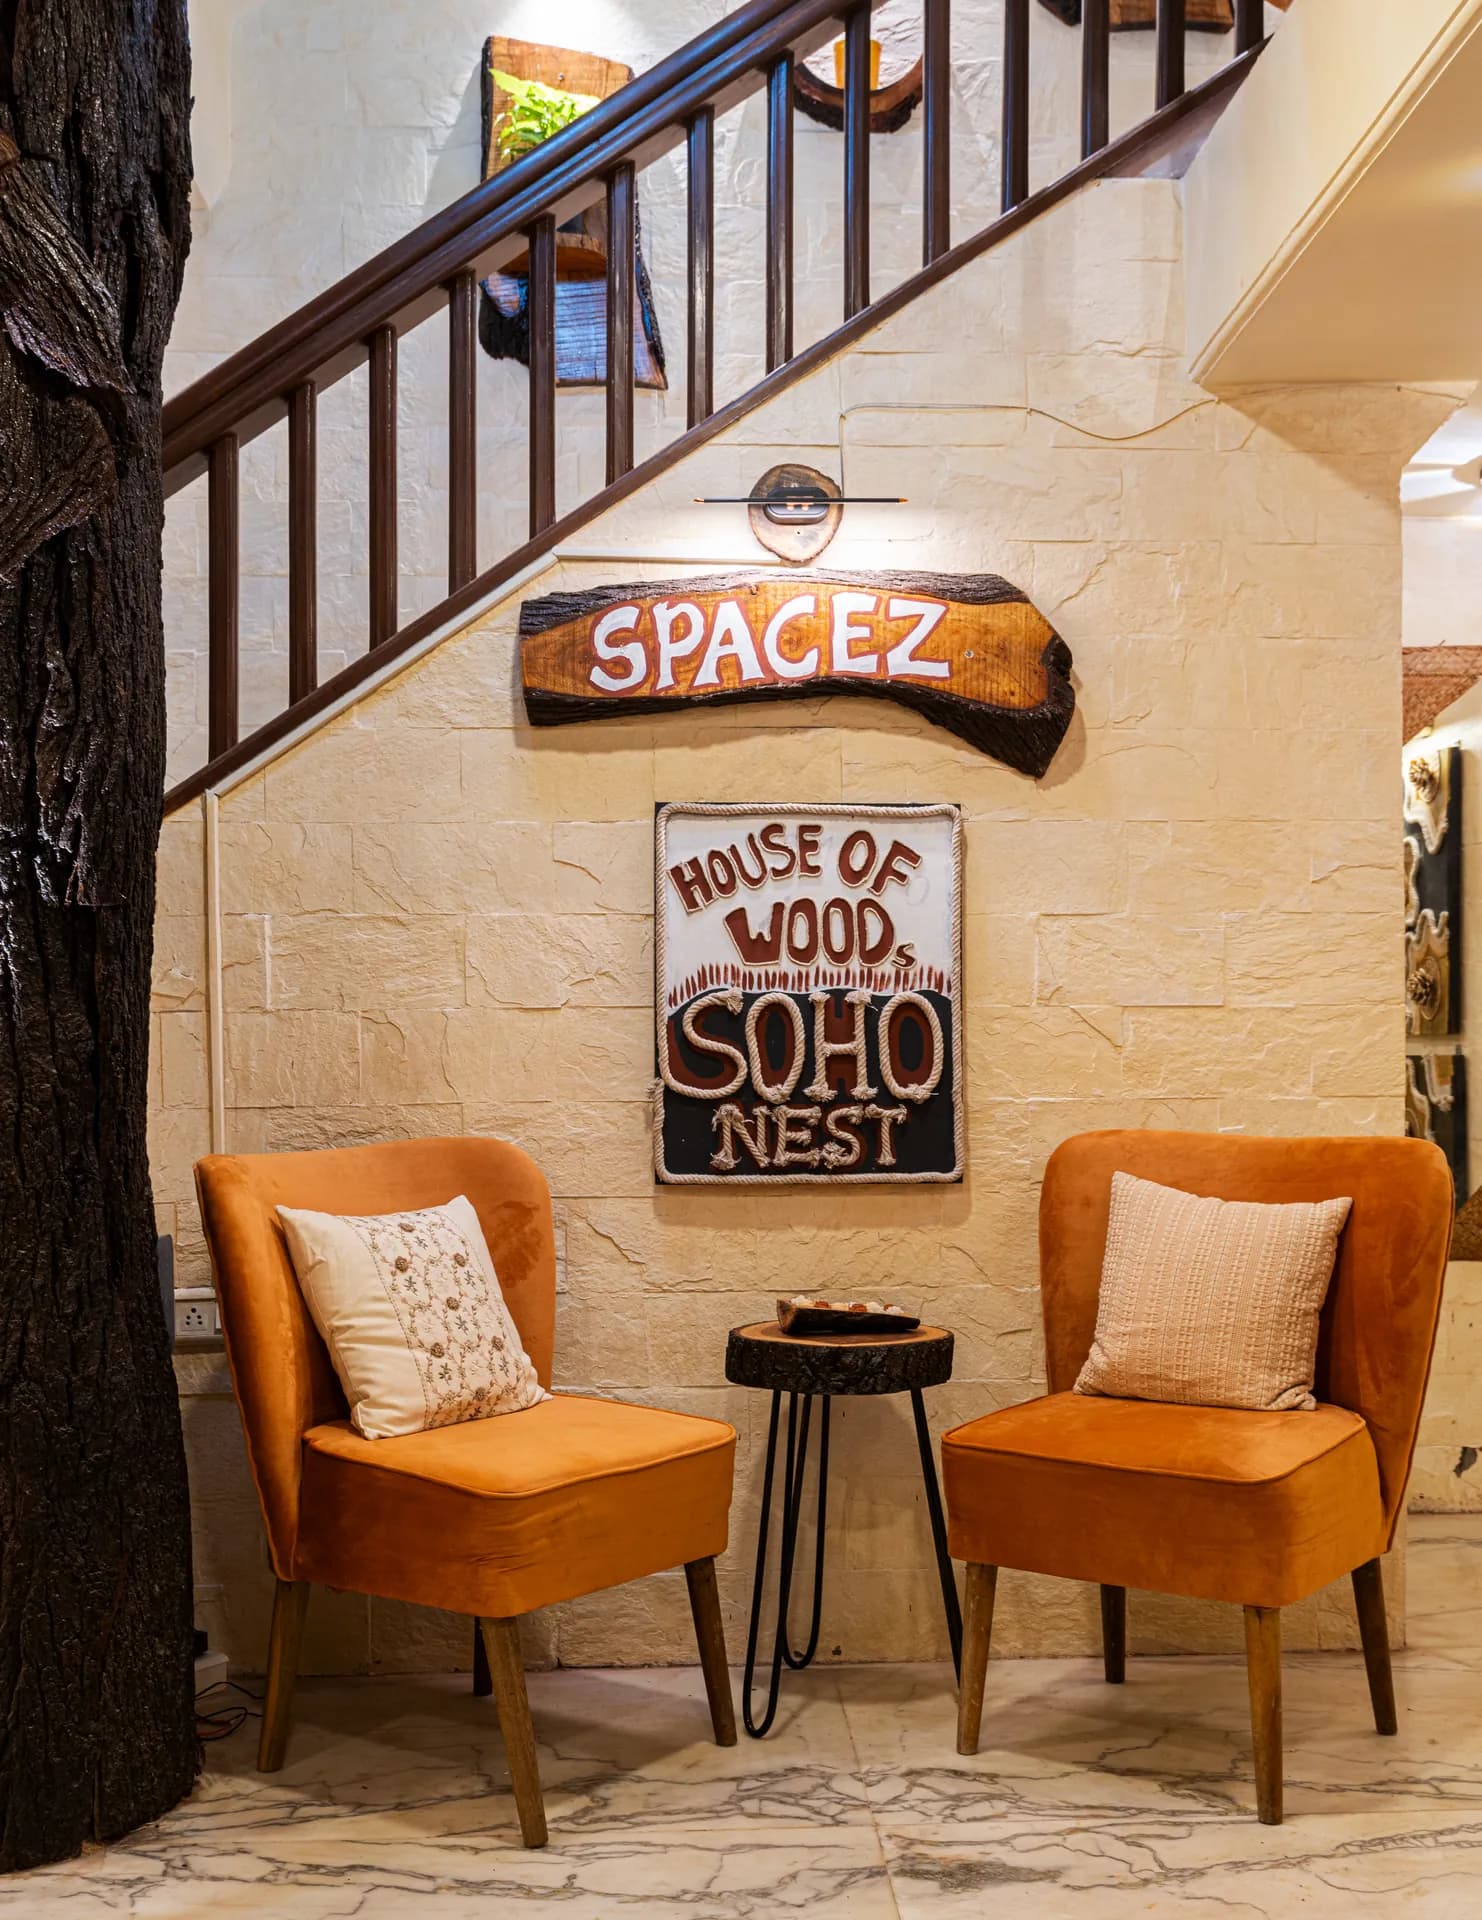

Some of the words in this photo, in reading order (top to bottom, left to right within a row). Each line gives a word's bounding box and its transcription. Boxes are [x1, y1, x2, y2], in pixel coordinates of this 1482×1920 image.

[588, 590, 952, 697] SPACEZ
[669, 823, 824, 914] HOUSE
[838, 829, 923, 897] OF
[664, 987, 944, 1104] SOHO
[709, 1102, 908, 1172] NEST
